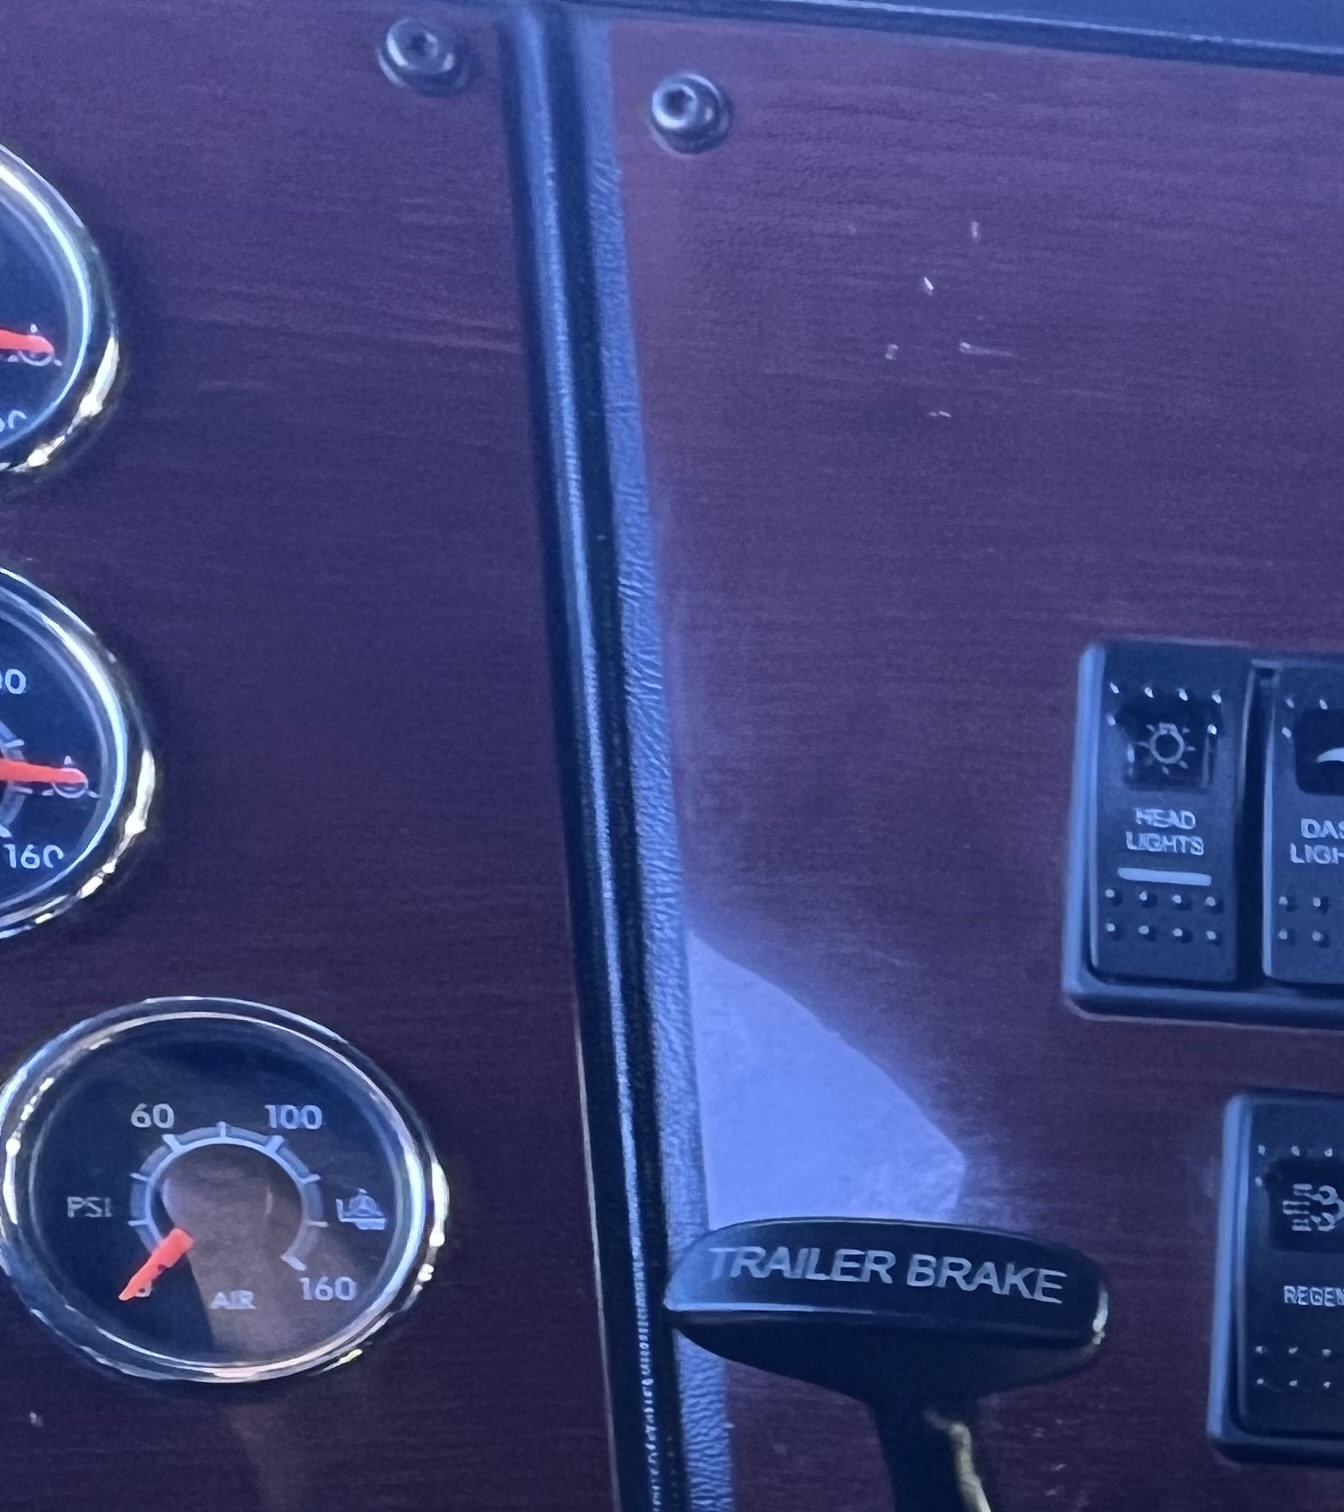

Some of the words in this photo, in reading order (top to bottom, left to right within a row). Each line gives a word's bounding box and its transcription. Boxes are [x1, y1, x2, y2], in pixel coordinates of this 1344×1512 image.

[1134, 808, 1197, 830] HEAD
[1126, 832, 1204, 857] LIGHTS
[130, 1103, 175, 1129] 60
[264, 1104, 323, 1130] 100
[67, 1196, 113, 1218] PSI
[709, 1247, 897, 1284] TRAILER
[906, 1253, 1069, 1304] BRAKE
[211, 1290, 256, 1310] AIR
[301, 1277, 357, 1301] 160
